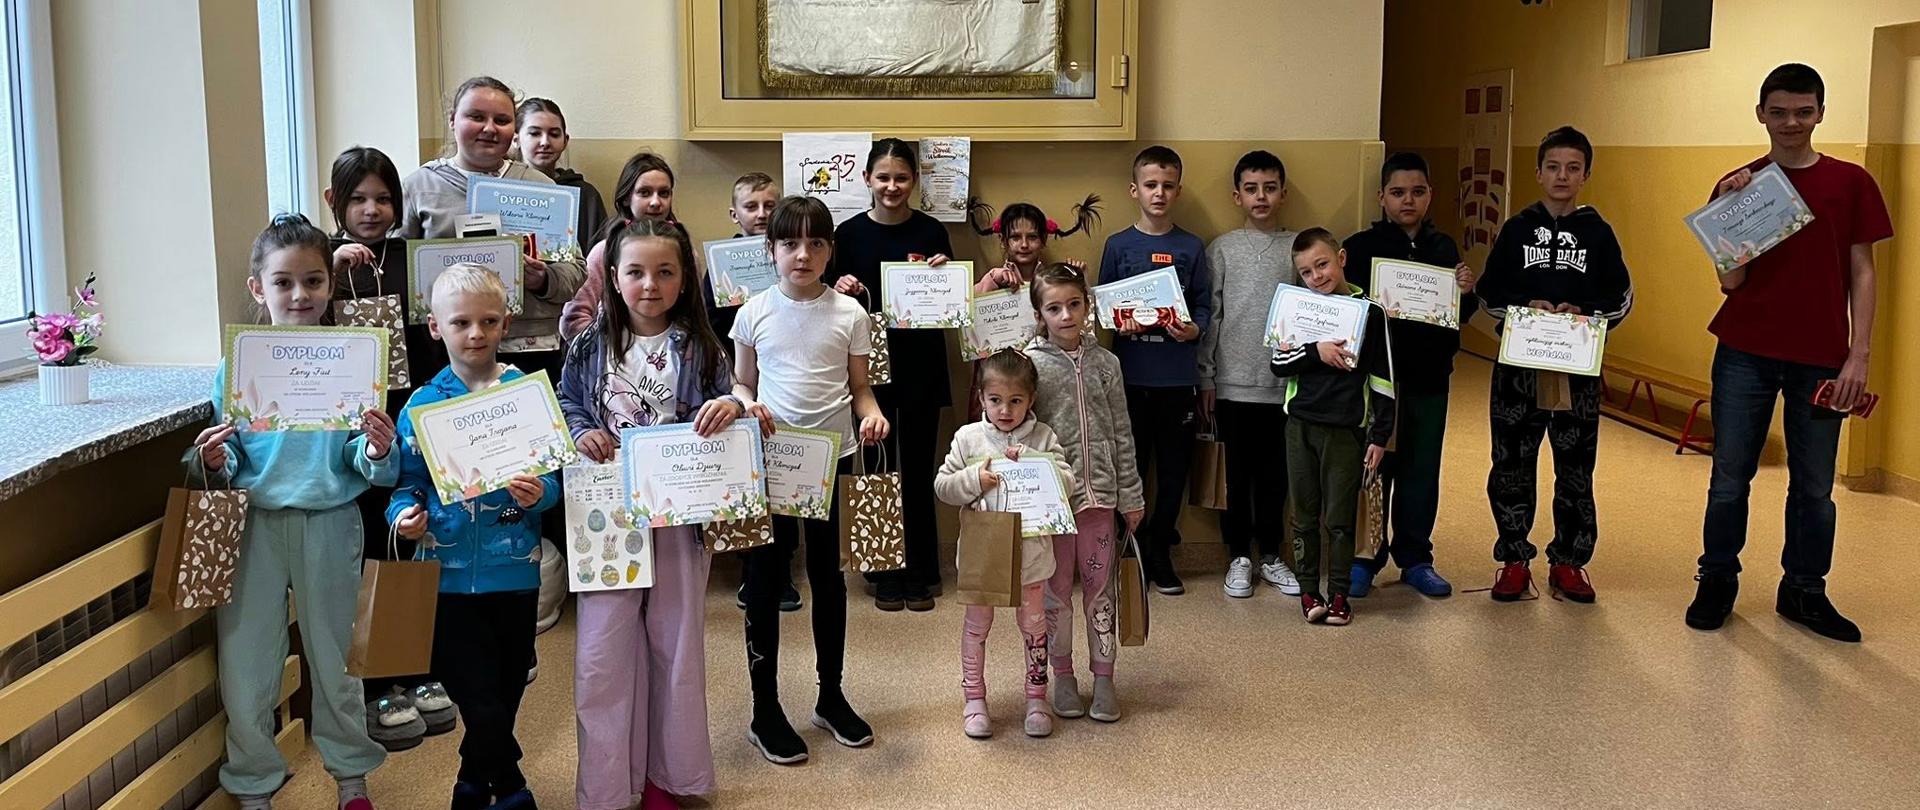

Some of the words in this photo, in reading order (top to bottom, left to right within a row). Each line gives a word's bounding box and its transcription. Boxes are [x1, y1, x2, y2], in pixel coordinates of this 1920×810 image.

[829, 154, 856, 178] 25
[500, 195, 549, 208] DYPLOM
[1719, 191, 1761, 221] DYPLOM
[443, 253, 495, 266] DYPLOM
[905, 274, 948, 283] DYPLOM
[1396, 271, 1437, 286] DYPLOM
[1115, 285, 1155, 299] DYPLOM
[979, 300, 1019, 315] DYPLOM
[1298, 300, 1340, 316] DYPLOM
[272, 345, 345, 360] DYPLOM
[1527, 348, 1572, 361] DYPLOM
[453, 401, 518, 430] DYPLOM
[662, 440, 726, 458] DYPLOM
[765, 441, 804, 457] PLOM
[1003, 468, 1040, 480] YPLOM
